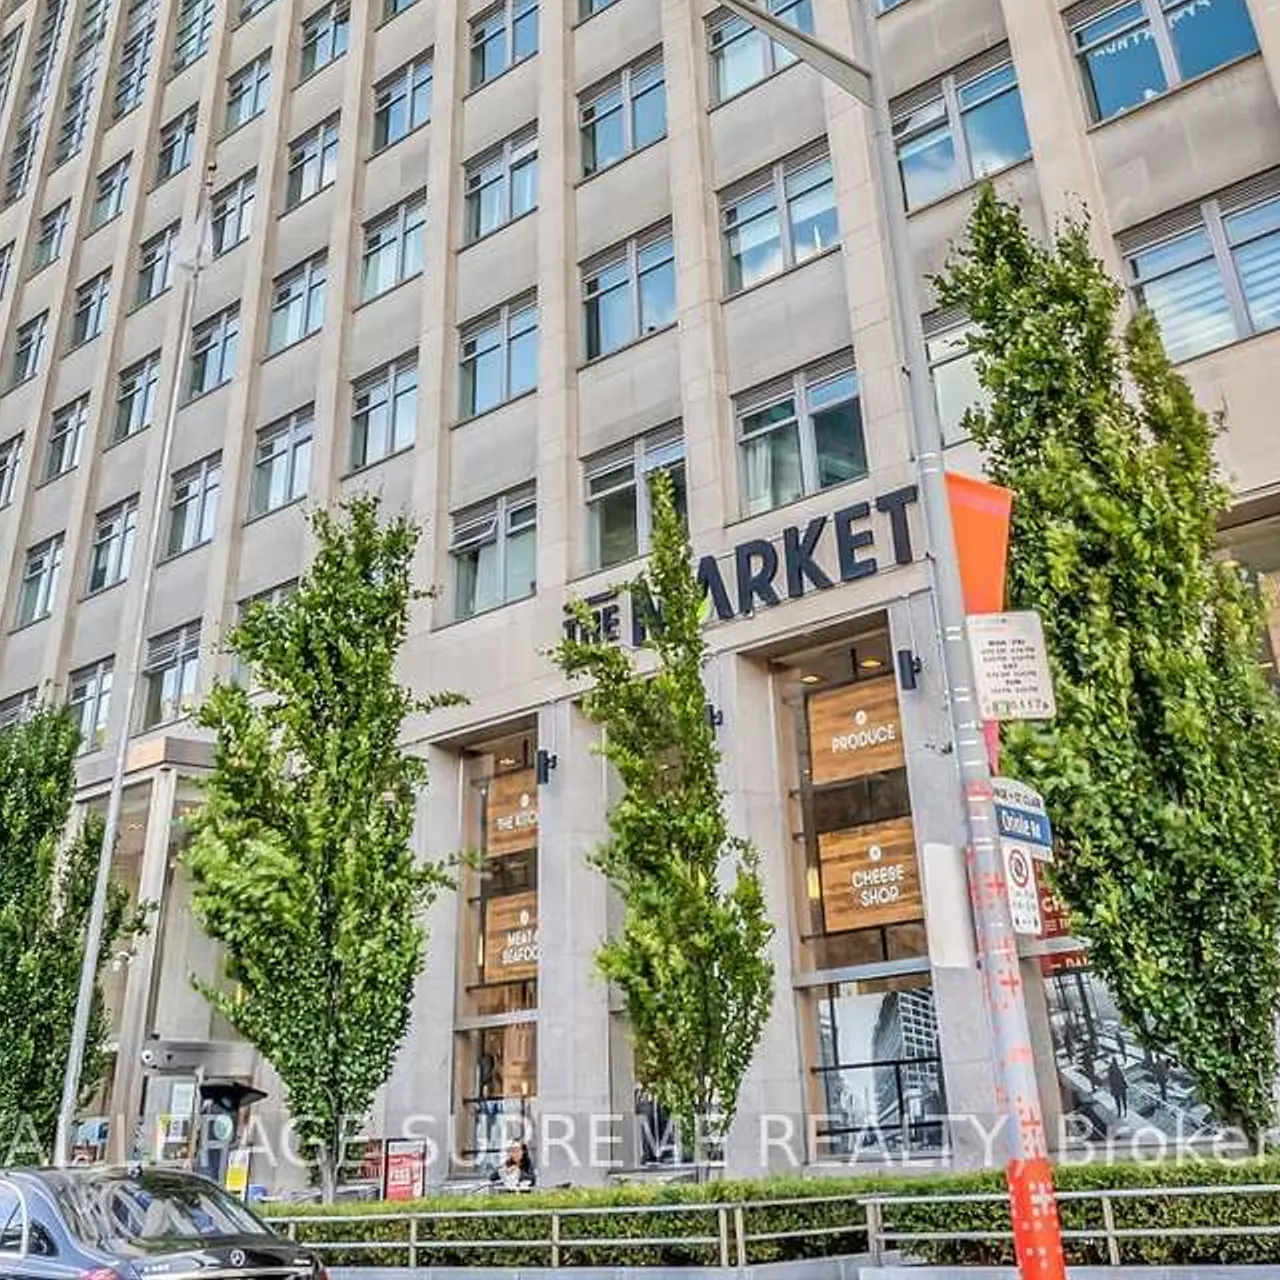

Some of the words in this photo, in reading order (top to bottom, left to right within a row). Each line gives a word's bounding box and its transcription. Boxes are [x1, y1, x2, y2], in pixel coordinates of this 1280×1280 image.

[629, 485, 918, 647] MARKET
[831, 723, 896, 754] PRODUCE
[851, 864, 904, 889] CHEESE
[860, 885, 900, 908] SHOP
[501, 945, 545, 965] SEAFOO
